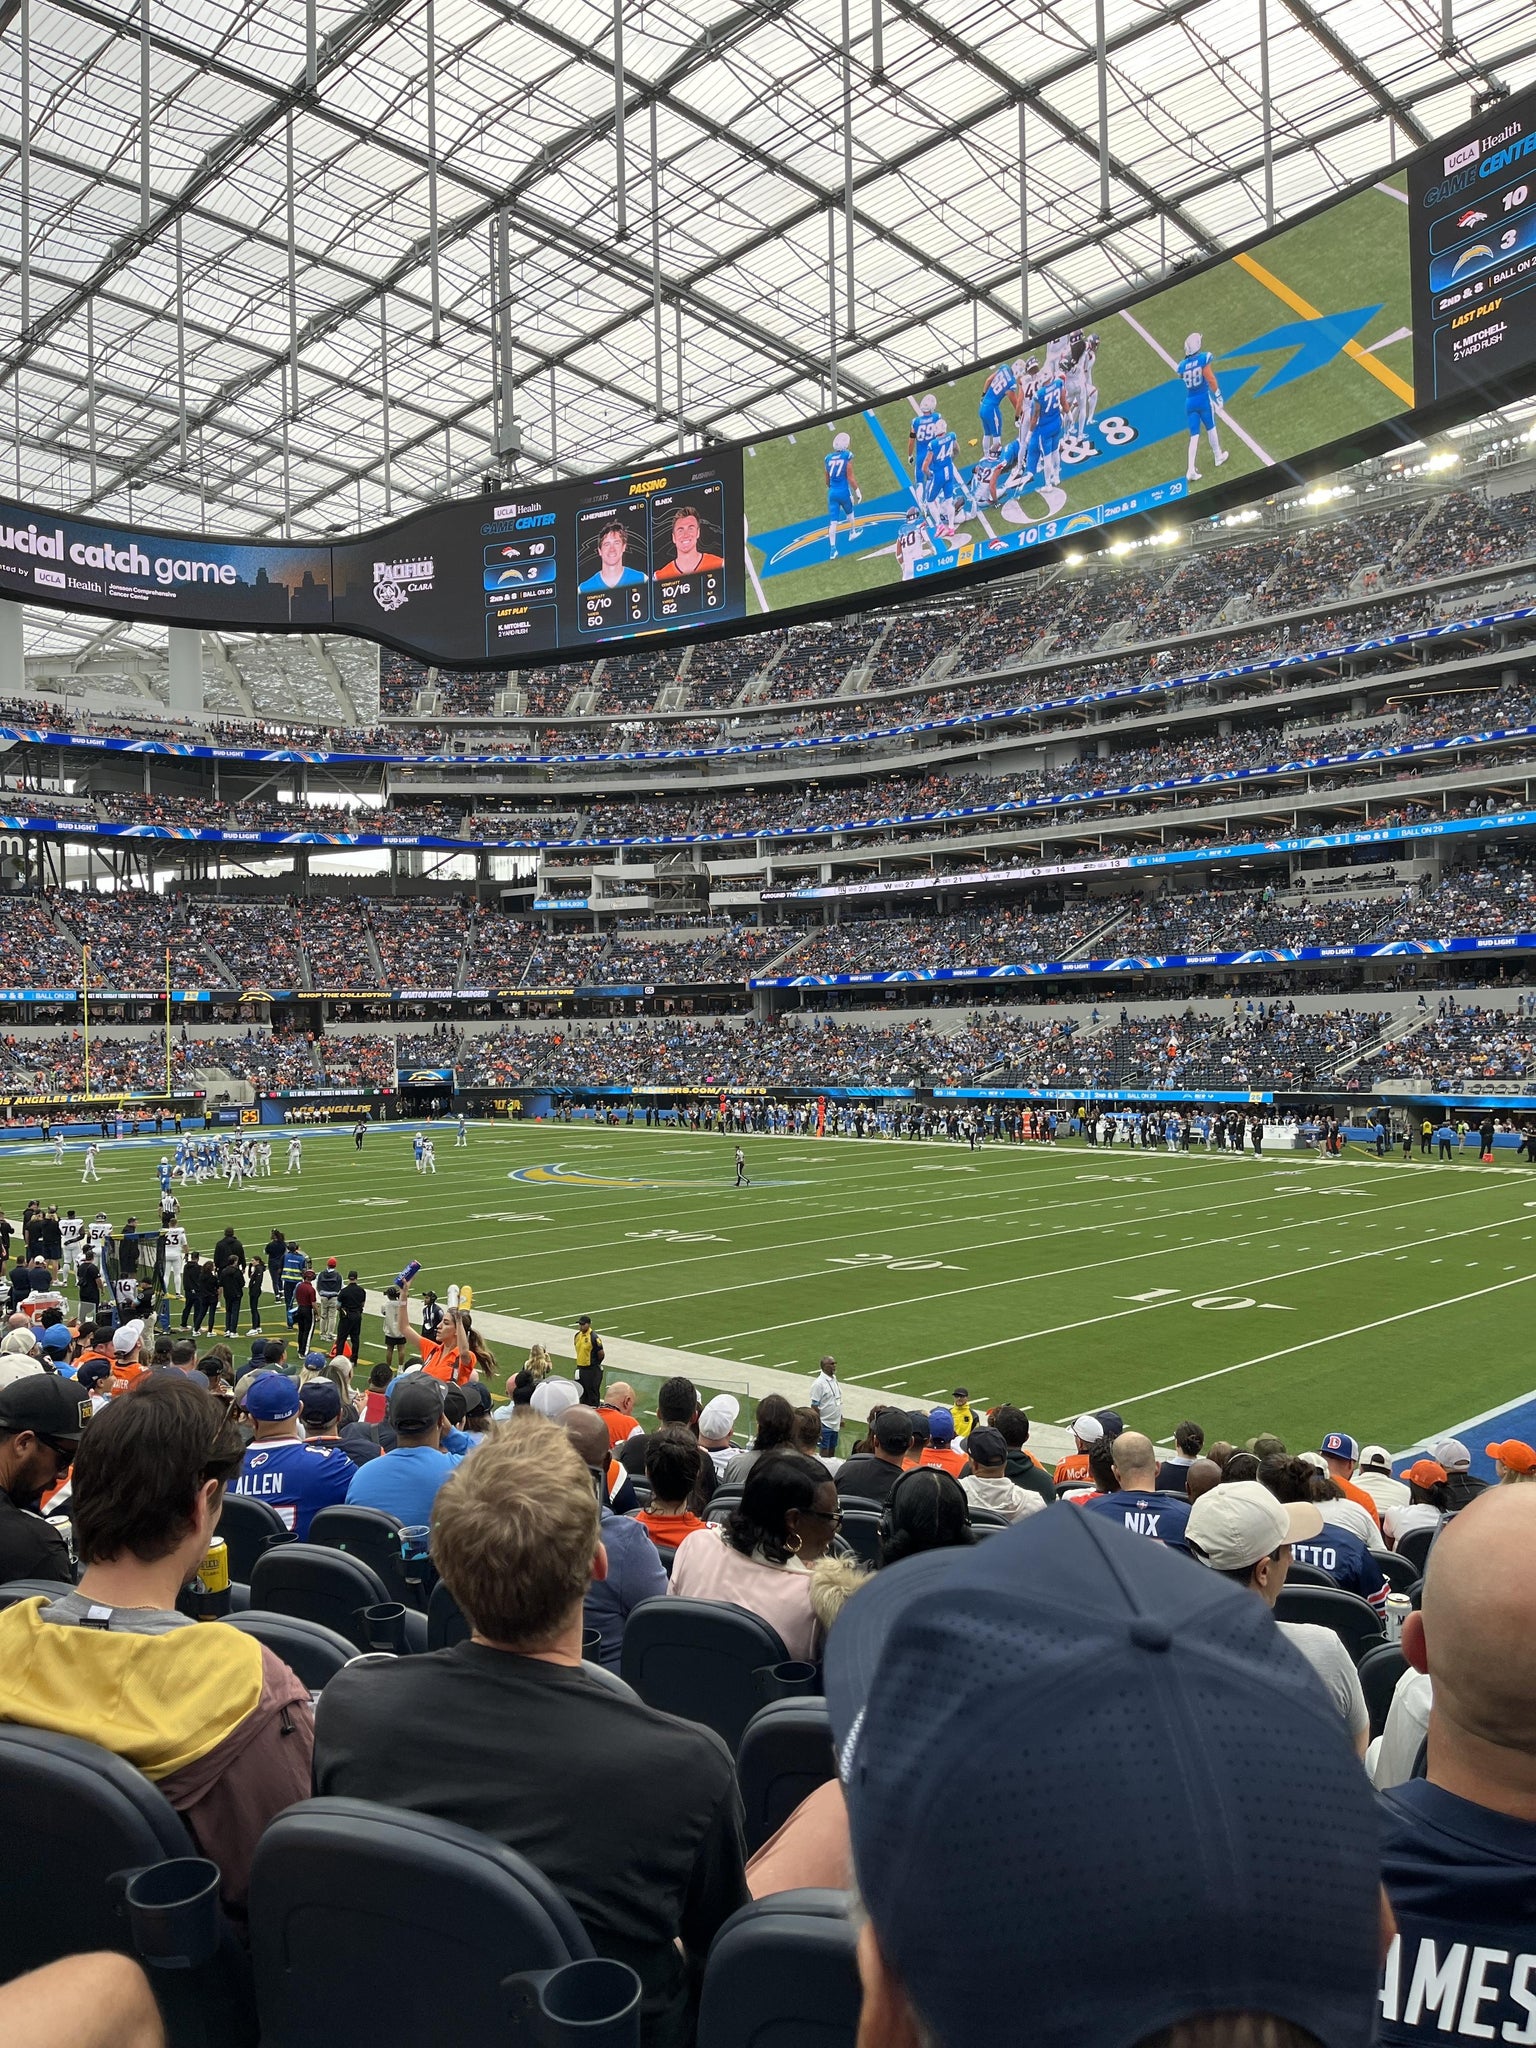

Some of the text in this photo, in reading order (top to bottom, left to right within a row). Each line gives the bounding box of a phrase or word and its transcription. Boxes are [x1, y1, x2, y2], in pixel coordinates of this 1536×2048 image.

[1449, 121, 1521, 168] UCLA Health
[1423, 164, 1477, 208] GAME
[1502, 185, 1528, 211] 10
[1500, 229, 1517, 250] 3
[1439, 260, 1531, 310] 2ND & 8 BALL ON
[1451, 297, 1502, 329] LAST PLAY
[1462, 321, 1508, 345] MITCHELL
[1453, 333, 1503, 361] 2 YARD RUSH
[1044, 389, 1061, 413] 73
[916, 422, 934, 442] 69
[1098, 416, 1138, 446] 8
[937, 442, 954, 462] 44
[828, 459, 844, 477] 77
[628, 477, 667, 495] PASSING
[1169, 482, 1182, 495] 29
[517, 502, 542, 514] Health
[580, 508, 617, 522] J.HERBERT
[1104, 506, 1121, 517] 2ND
[480, 513, 556, 536] GAME CENTER
[900, 531, 916, 549] 40
[1017, 523, 1057, 546] 10 3
[529, 543, 545, 555] 10
[69, 543, 150, 576] catch
[154, 557, 237, 585] game
[916, 561, 930, 572] Q3
[18, 567, 29, 576] by
[373, 561, 435, 583] PACIFICO
[527, 567, 538, 579] 3
[39, 573, 102, 593] UCLA Health
[407, 582, 433, 592] CLARA
[707, 578, 717, 589] 0
[108, 583, 177, 598] Jonsson Comprehensive
[108, 590, 150, 601] Cancer Center
[631, 592, 641, 603] 0
[661, 583, 691, 598] 10/16
[586, 597, 612, 612] 6/10
[707, 595, 717, 606] 0
[497, 606, 529, 617] LAST PLAY
[632, 609, 641, 620] 0
[662, 603, 678, 615] 82
[587, 615, 603, 627] 50
[1334, 836, 1341, 844] 3
[1354, 825, 1443, 842] 2ND & 8 BALL ON 29
[1056, 865, 1066, 873] 14
[1110, 860, 1121, 868] 13
[400, 991, 427, 999] AVIATOR
[456, 990, 489, 998] CHARGERS
[631, 1087, 767, 1095] CHARGERS.COM/TICKETS
[13, 1095, 67, 1105] ANGELES
[242, 1110, 257, 1122] 25
[61, 1225, 76, 1236] 79
[624, 1228, 717, 1242] 30
[825, 1252, 943, 1271] 20
[118, 1280, 131, 1292] 16
[1112, 1287, 1256, 1311] 10
[1327, 1435, 1342, 1449] D
[235, 1472, 283, 1496] ALLEN
[1124, 1511, 1160, 1537] NIX
